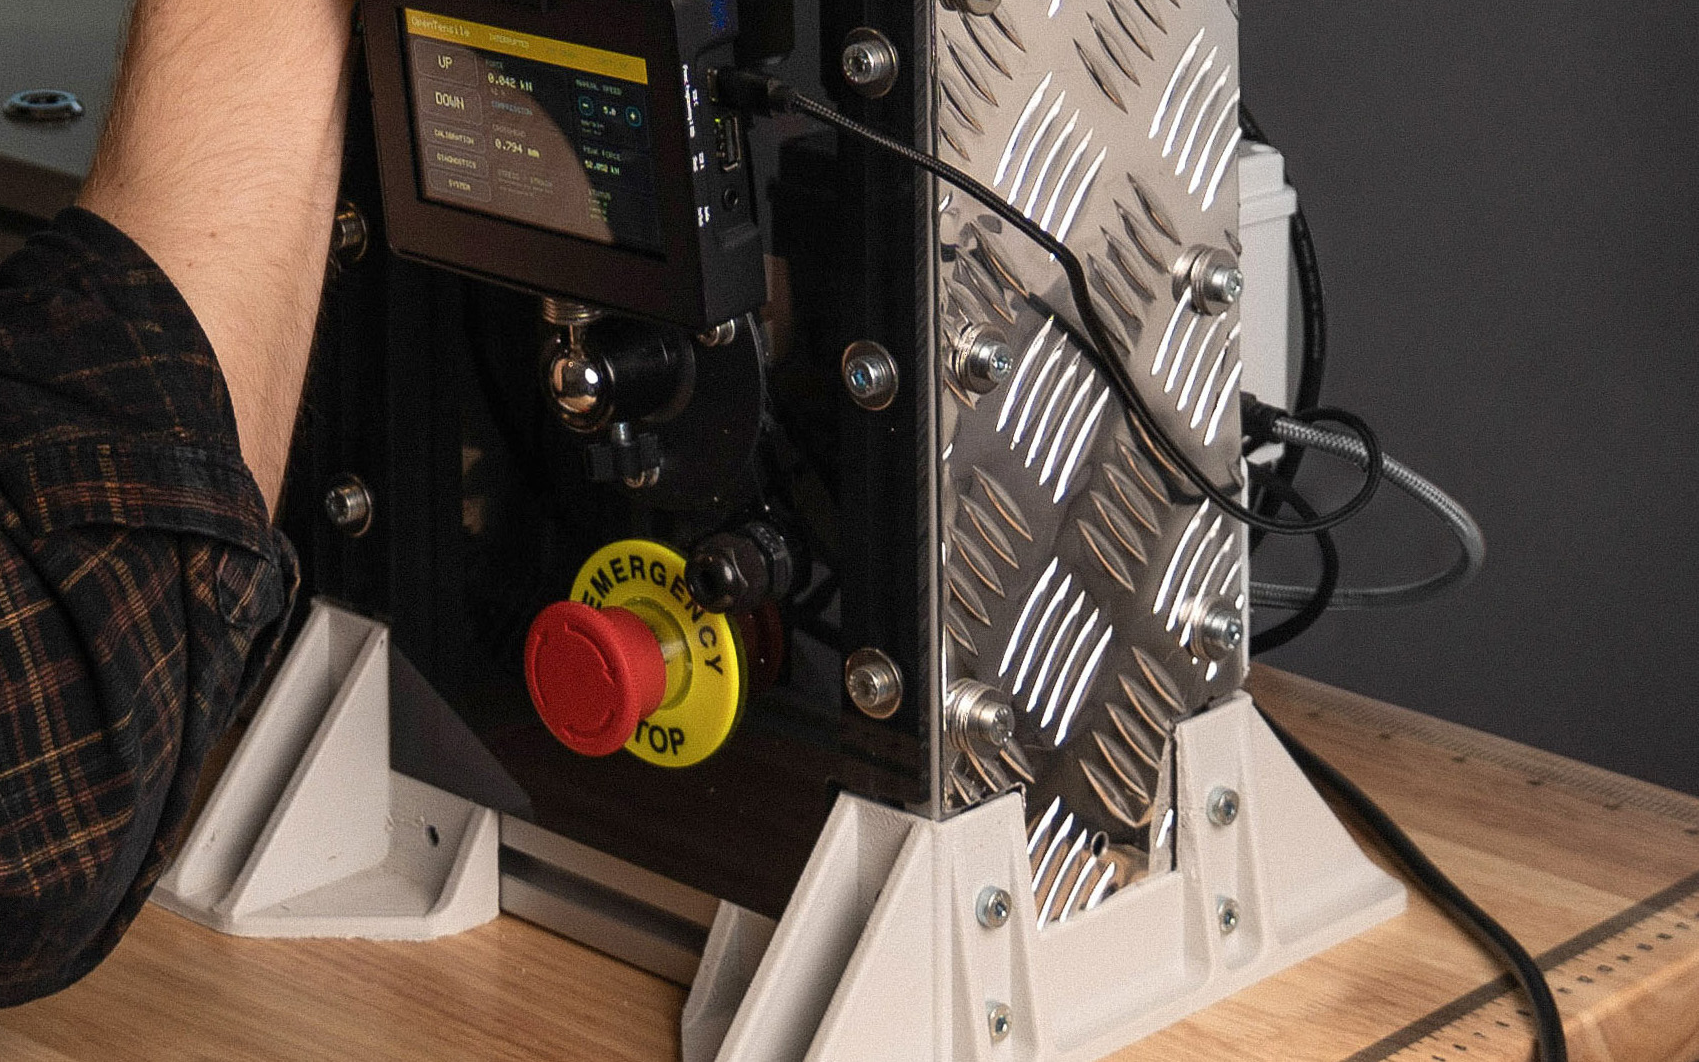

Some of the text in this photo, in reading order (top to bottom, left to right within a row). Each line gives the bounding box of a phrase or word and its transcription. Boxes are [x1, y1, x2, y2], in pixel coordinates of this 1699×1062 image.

[411, 17, 469, 37] OpenTensile
[437, 55, 453, 70] UP
[435, 91, 464, 110] DOWN
[582, 554, 723, 675] EMERGENCY
[634, 719, 685, 756] TOP
